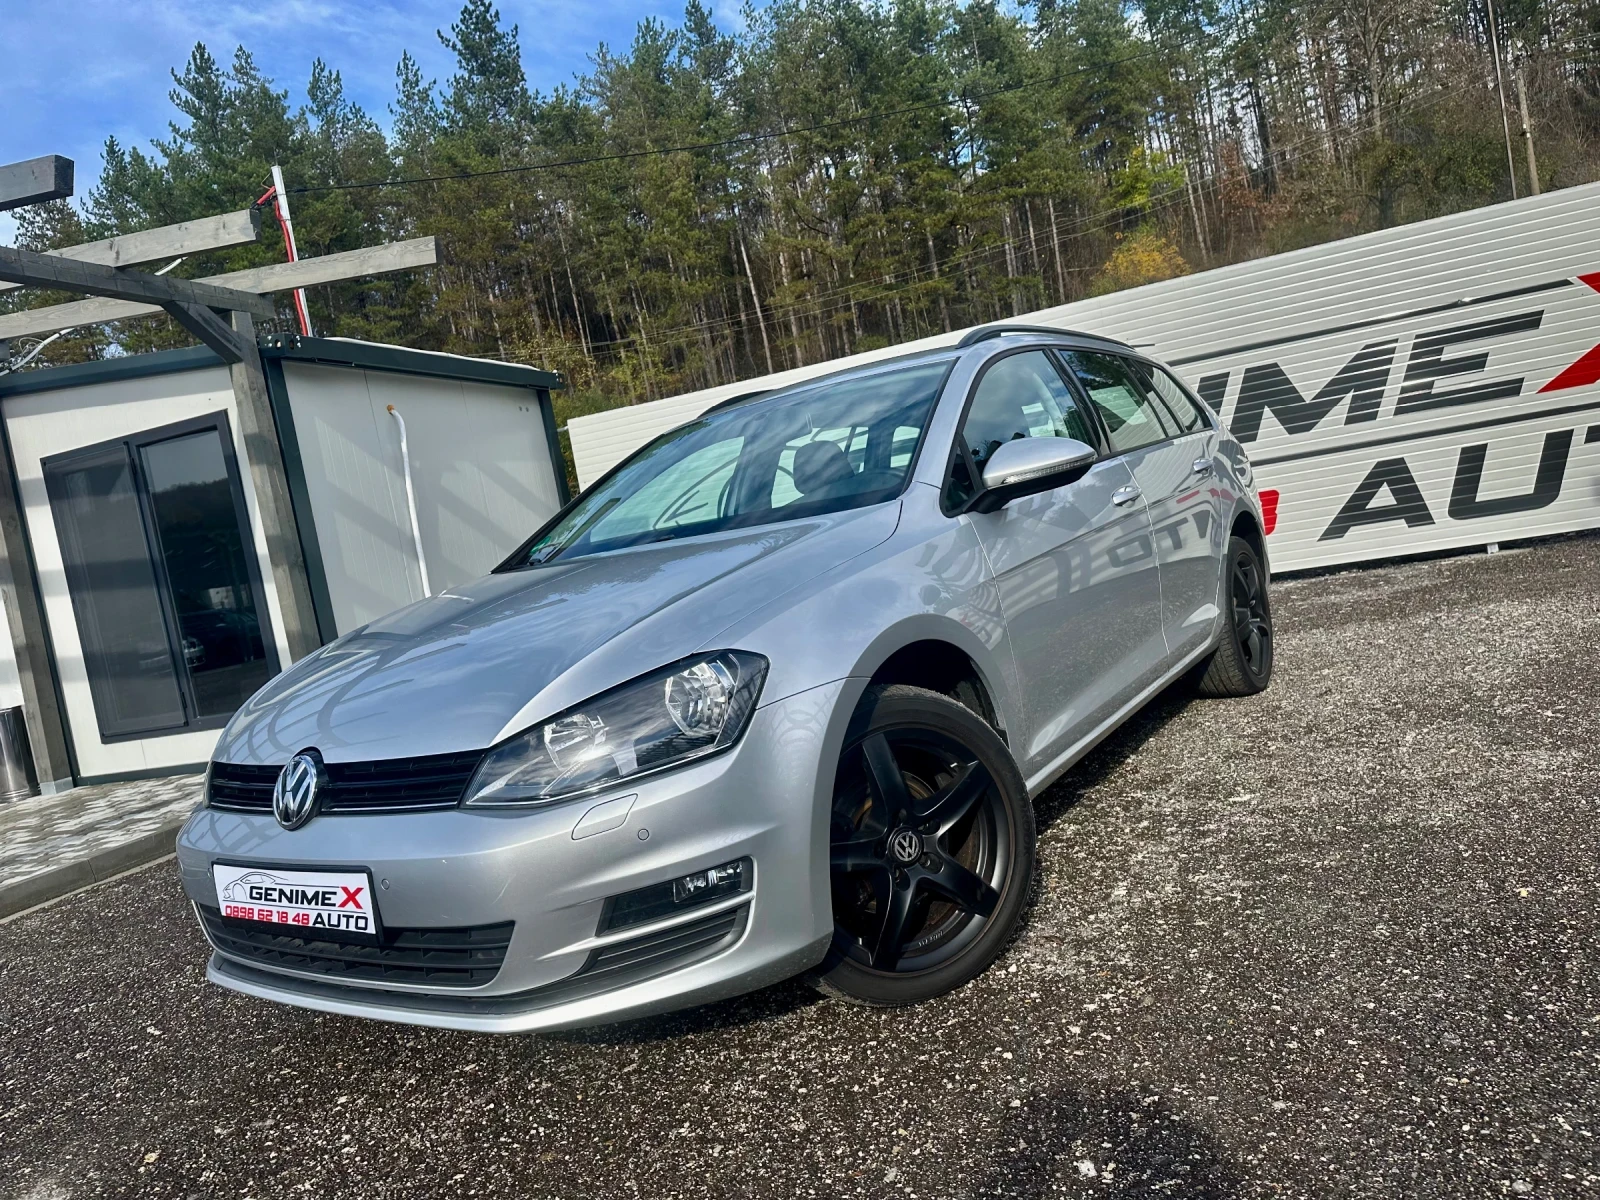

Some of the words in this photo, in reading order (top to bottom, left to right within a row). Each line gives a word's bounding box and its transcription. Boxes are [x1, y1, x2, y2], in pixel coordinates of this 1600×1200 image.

[1317, 425, 1600, 542] AU
[249, 885, 364, 909] GENIMEX
[225, 905, 254, 919] 0898
[257, 908, 273, 921] 62
[276, 910, 288, 923] 18
[292, 912, 310, 926] 48
[312, 912, 368, 931] AUTO
